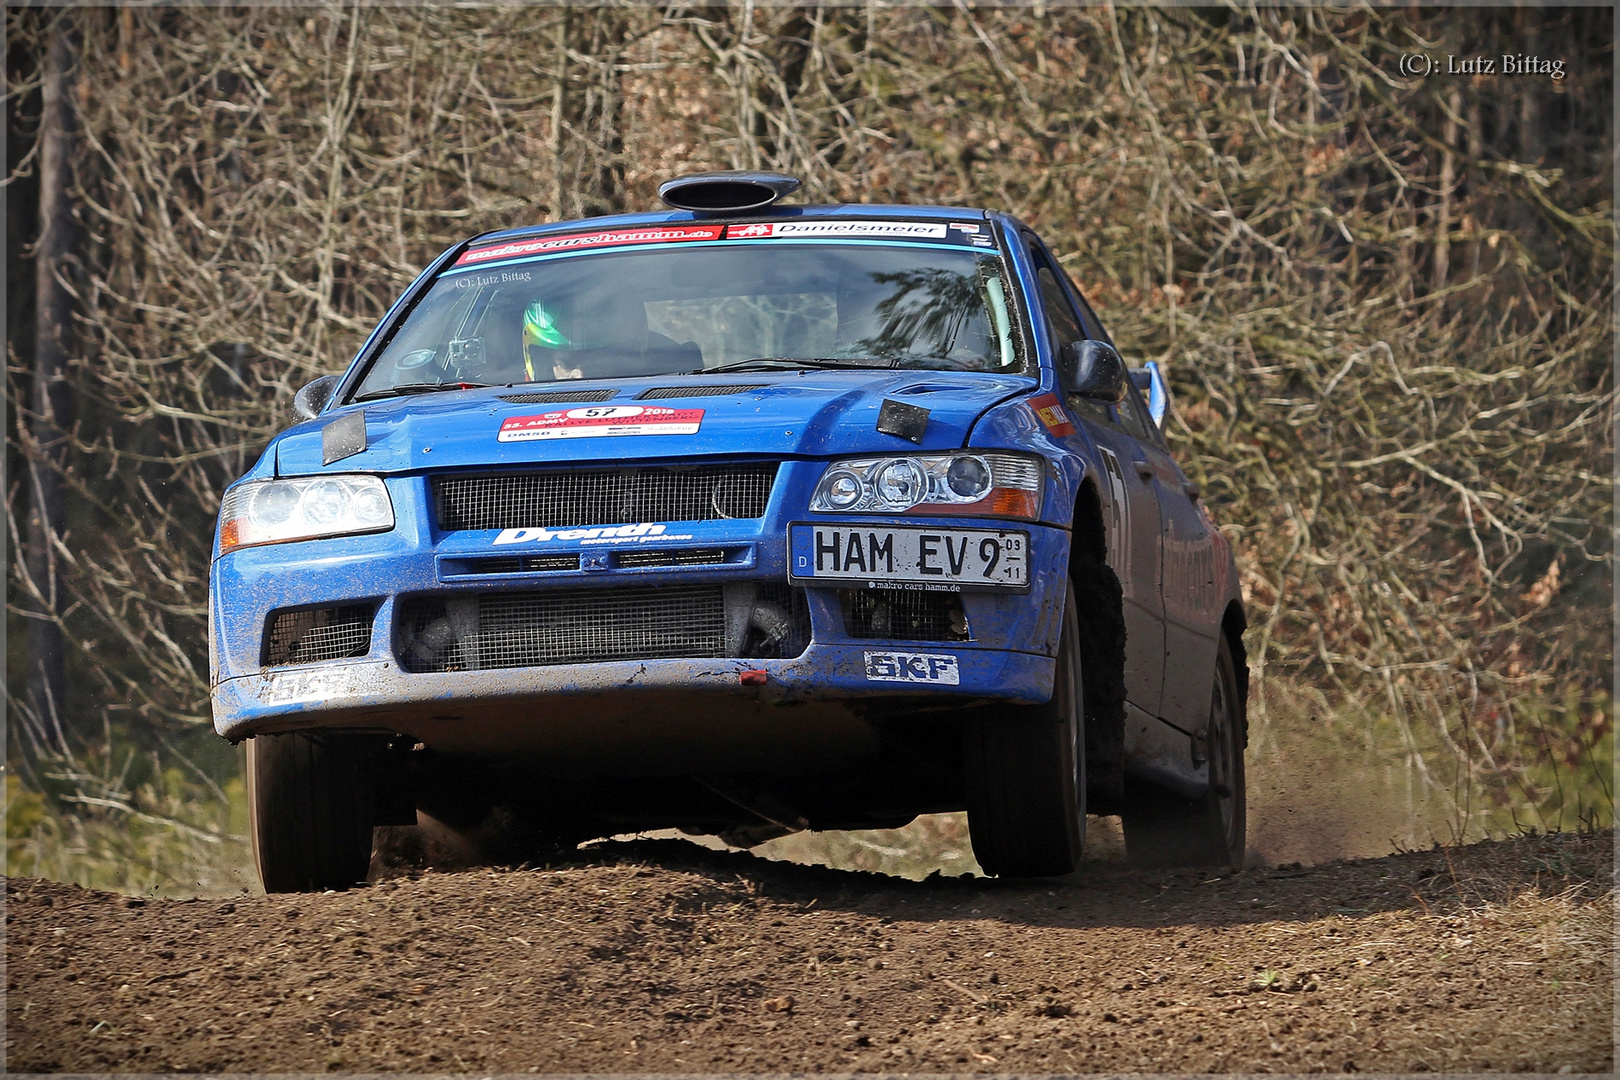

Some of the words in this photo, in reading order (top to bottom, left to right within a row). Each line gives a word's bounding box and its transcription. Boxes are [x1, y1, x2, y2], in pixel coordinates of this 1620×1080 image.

[778, 223, 939, 234] Danielsmeier
[464, 230, 714, 261] makrocarshamm.de
[586, 408, 617, 417] 57
[526, 417, 569, 426] ADMV
[492, 523, 667, 546] Drenth
[579, 536, 640, 545] motorsport
[641, 534, 693, 543] gearboxes
[1006, 539, 1021, 551] 03
[798, 556, 808, 567] D
[815, 531, 893, 573] HAM
[919, 535, 968, 576] EV
[979, 538, 1001, 577] 9
[1007, 567, 1021, 579] 11
[877, 581, 902, 590] makro
[904, 582, 923, 590] cars
[925, 583, 961, 593] hamm.de
[865, 656, 954, 679] SKF
